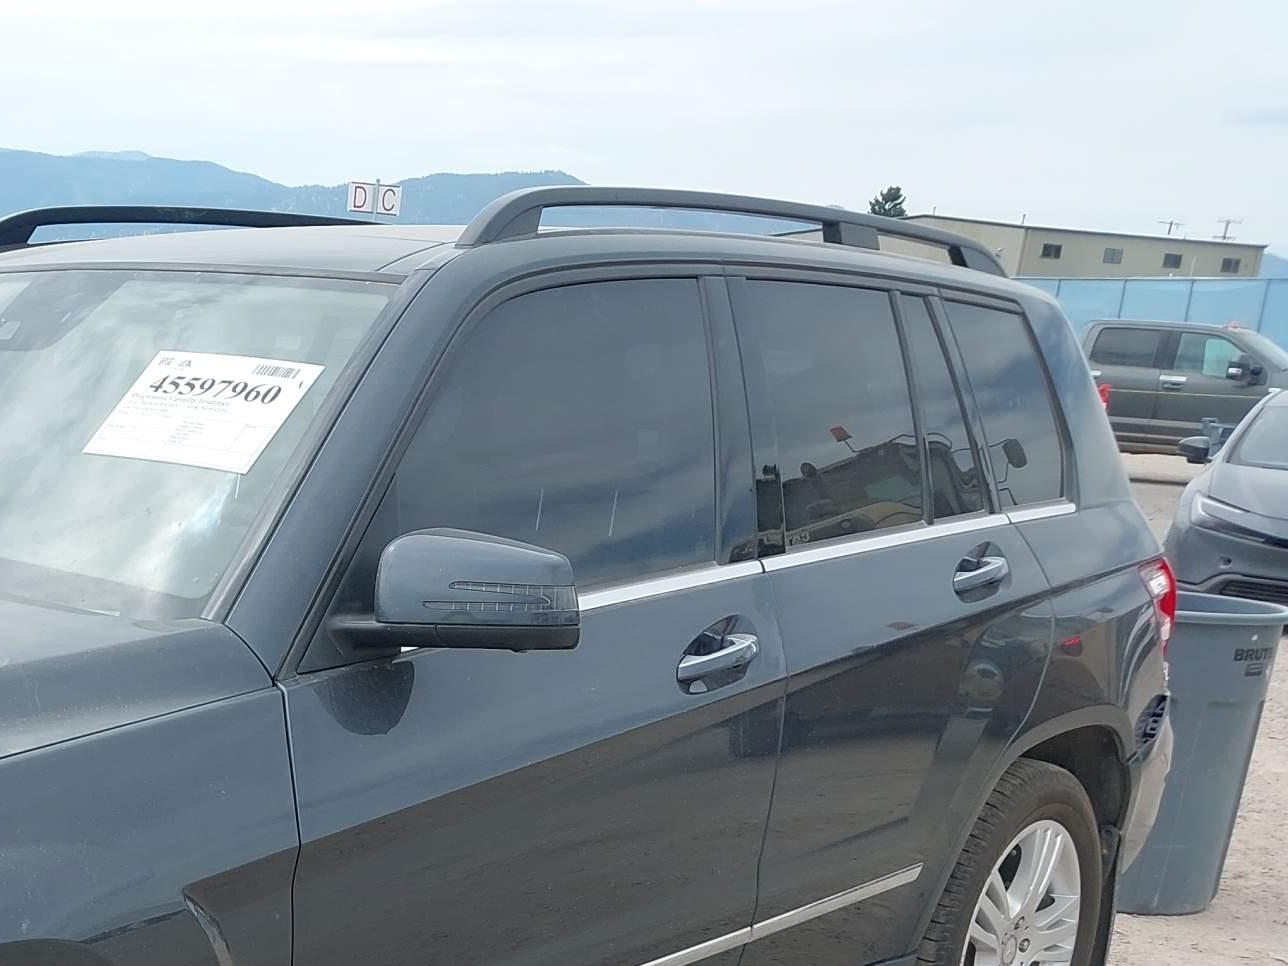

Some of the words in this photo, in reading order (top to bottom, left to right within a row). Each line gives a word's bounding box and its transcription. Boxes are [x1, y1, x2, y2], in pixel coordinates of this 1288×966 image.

[353, 186, 367, 208] D
[382, 189, 396, 211] C
[149, 375, 281, 404] 45597960
